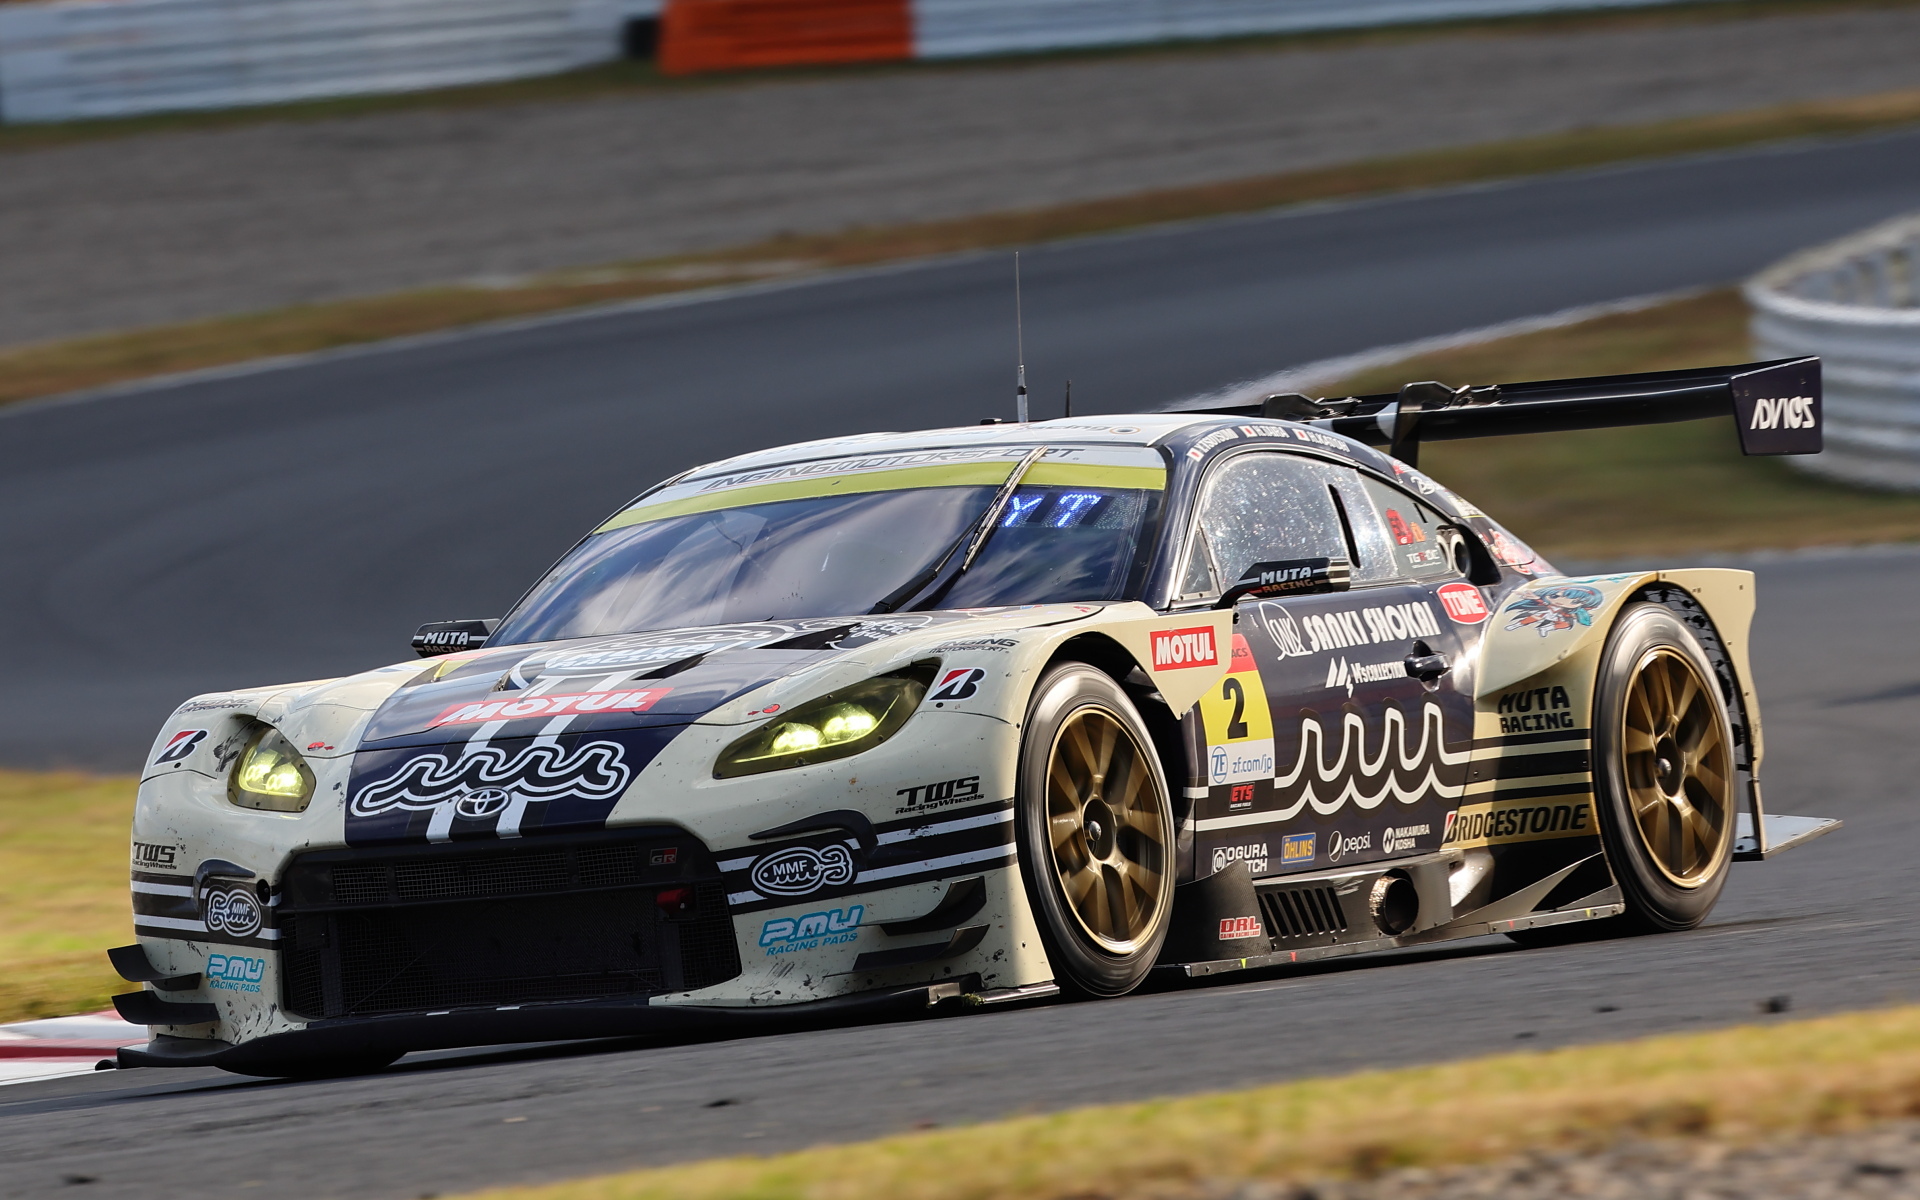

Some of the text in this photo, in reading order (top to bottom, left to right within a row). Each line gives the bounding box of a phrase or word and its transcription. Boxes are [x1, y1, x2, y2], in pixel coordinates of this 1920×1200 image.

[1261, 566, 1313, 585] MUTA
[1261, 579, 1314, 594] RACING
[1442, 589, 1485, 616] TONE
[1303, 602, 1441, 652] SANKI SHOKAI
[423, 631, 469, 645] MUTA
[1156, 632, 1214, 665] MOTUL
[439, 691, 651, 724] MOTUL
[1222, 678, 1249, 739] 2
[1498, 685, 1571, 714] MUTA
[1499, 711, 1575, 734] RACING
[1232, 754, 1273, 774] zf.com/jp
[1231, 785, 1254, 802] ETS
[1446, 803, 1590, 843] BRIDGESTONE
[1226, 843, 1268, 861] OGURA
[1283, 838, 1313, 859] ÖHLINS
[1342, 831, 1371, 855] pepsi
[772, 860, 808, 876] MMF
[231, 902, 250, 915] MMF
[1220, 917, 1261, 933] DRL
[766, 933, 857, 956] RACING PADS
[210, 980, 260, 993] RACING PADS
